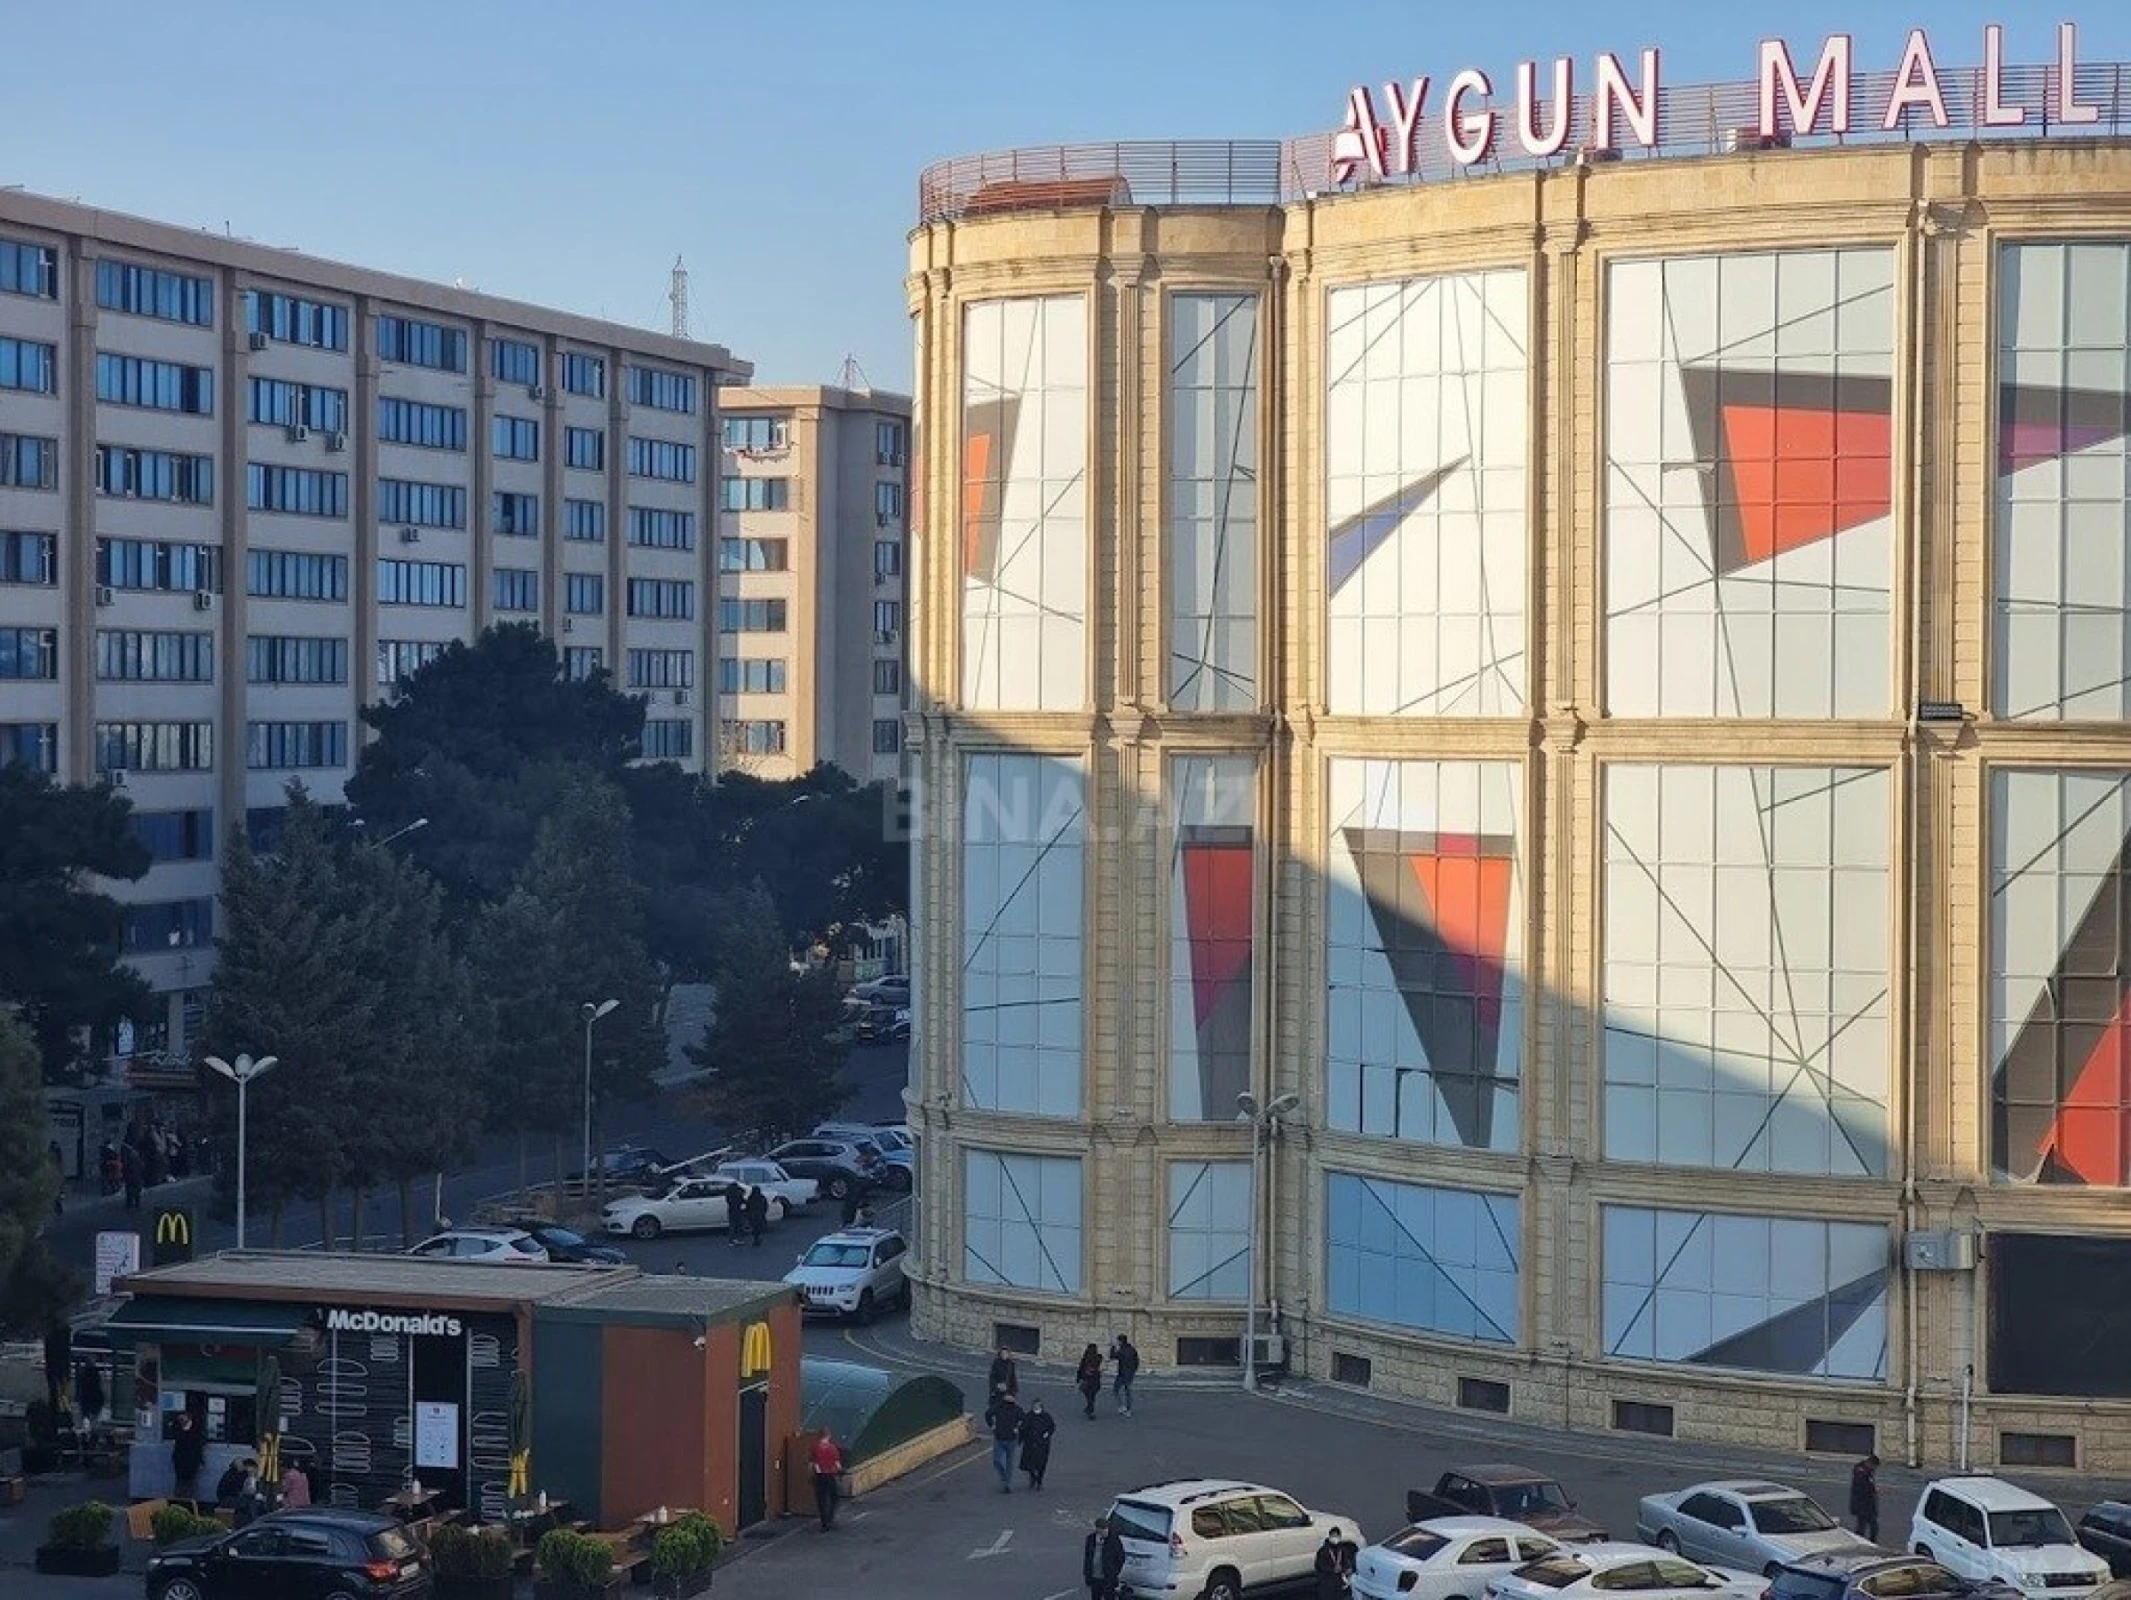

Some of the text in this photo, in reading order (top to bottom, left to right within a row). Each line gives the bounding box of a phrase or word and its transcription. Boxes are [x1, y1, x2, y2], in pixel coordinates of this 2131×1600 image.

[1335, 23, 2101, 183] AYGUN MALL
[326, 1309, 463, 1337] McDonald's
